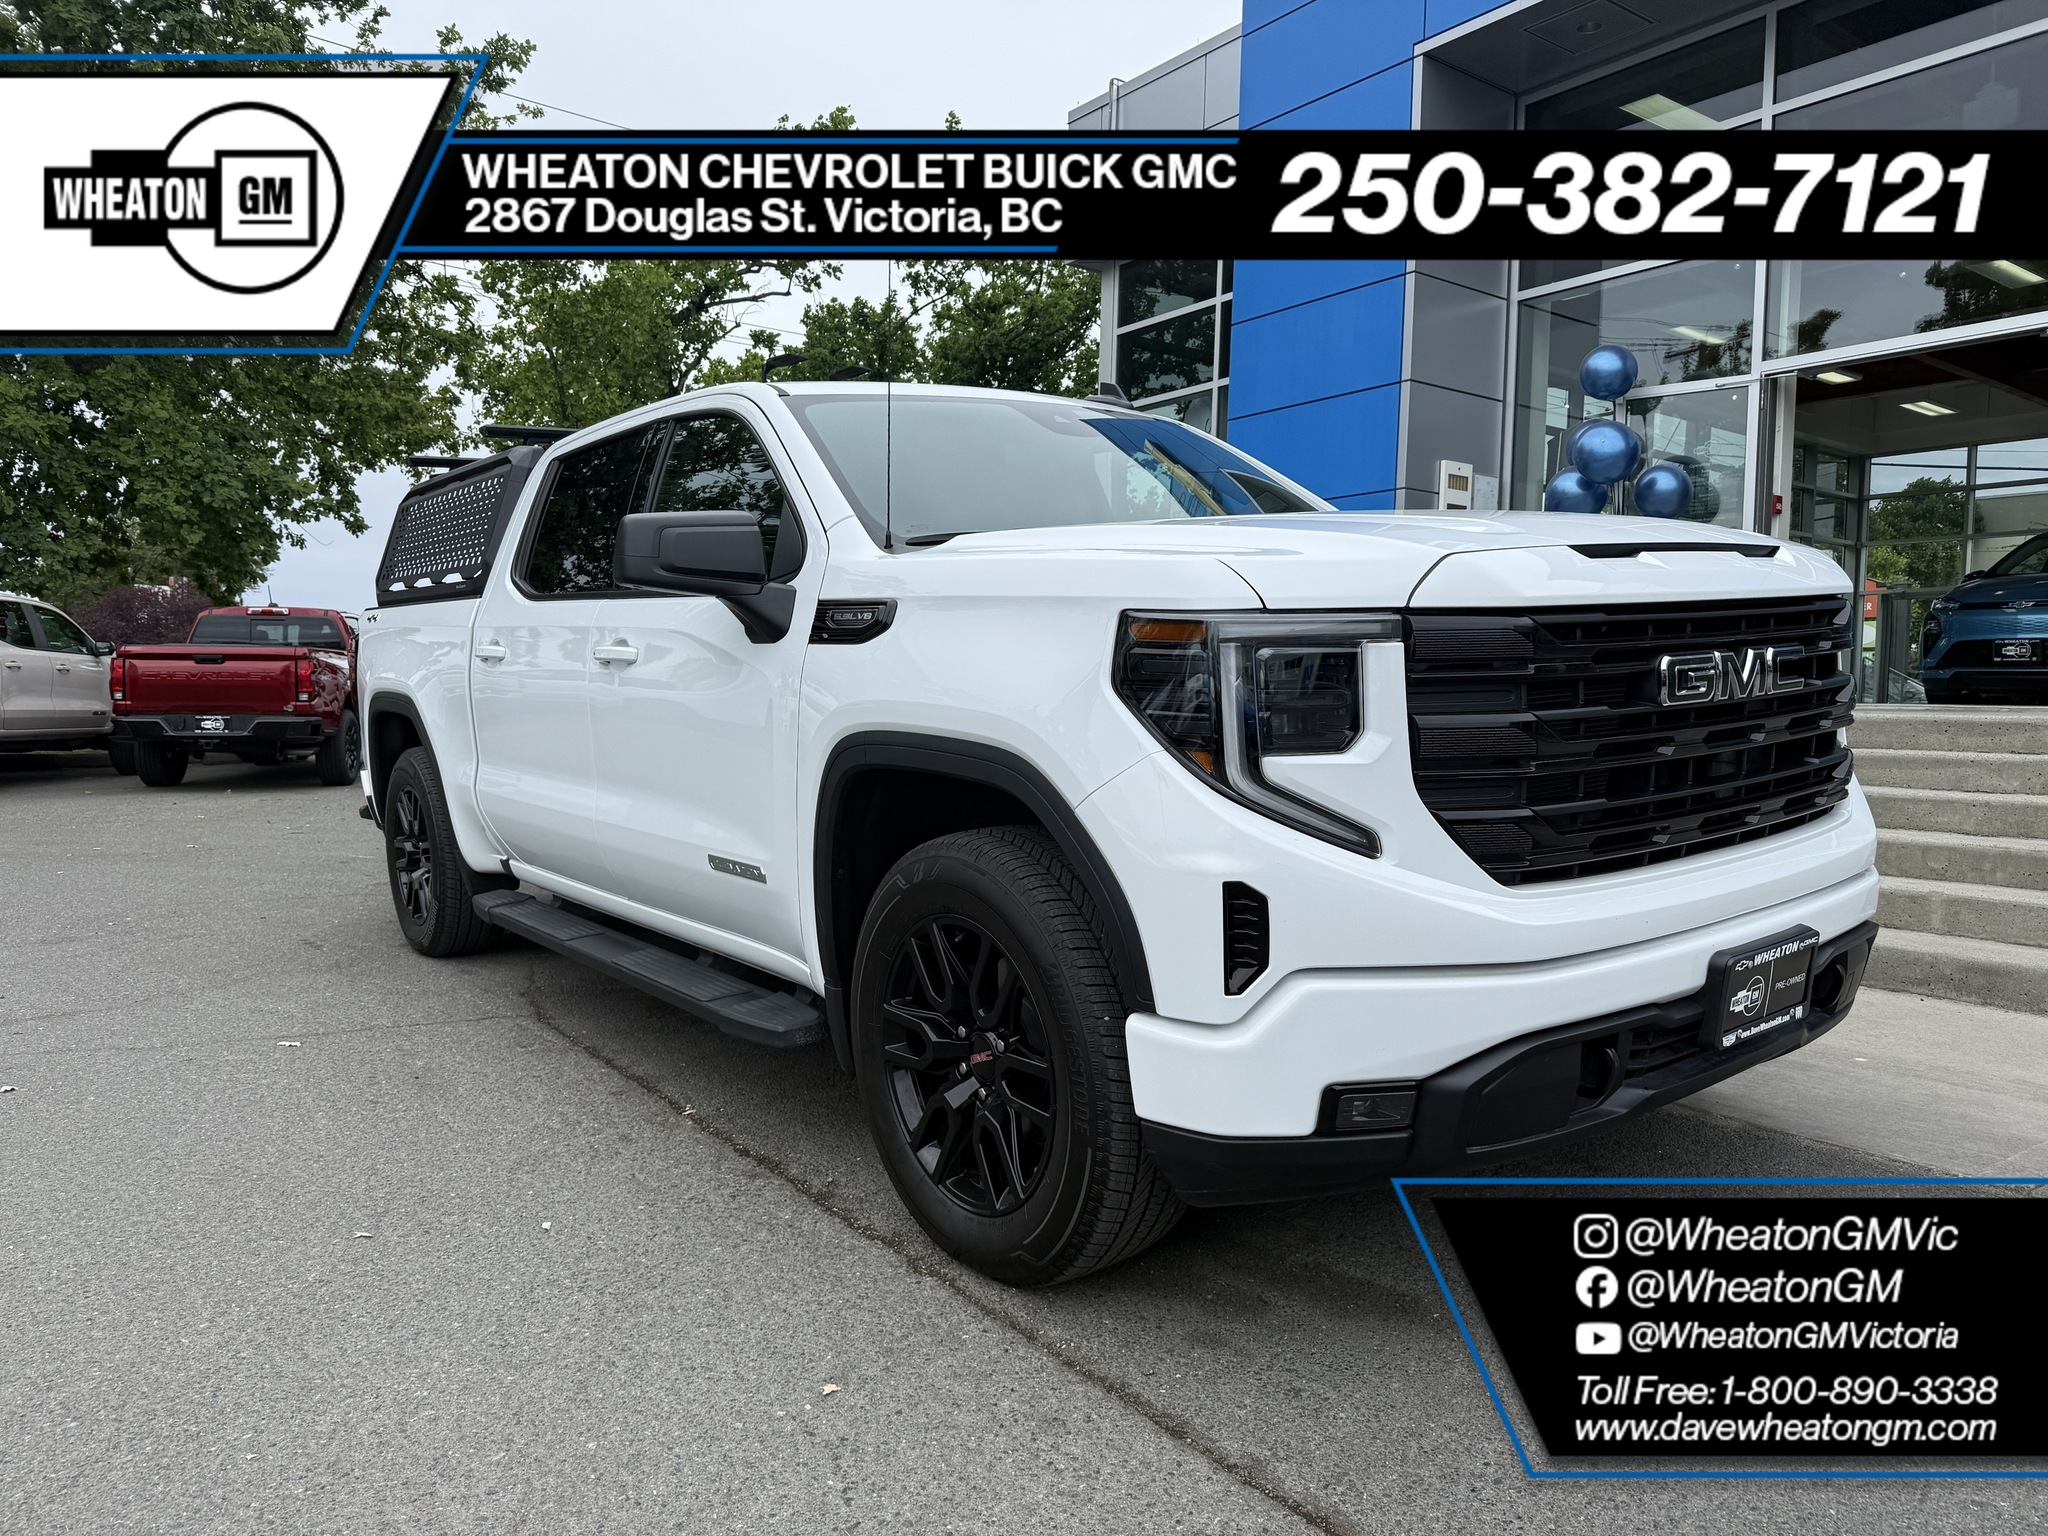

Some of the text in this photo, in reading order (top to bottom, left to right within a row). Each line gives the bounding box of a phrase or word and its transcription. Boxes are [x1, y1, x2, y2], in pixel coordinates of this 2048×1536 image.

[1658, 645, 1805, 706] GMC
[1754, 940, 1800, 966] WHEATON
[1774, 972, 1806, 991] PRE-OWNED
[970, 1051, 993, 1065] GMC
